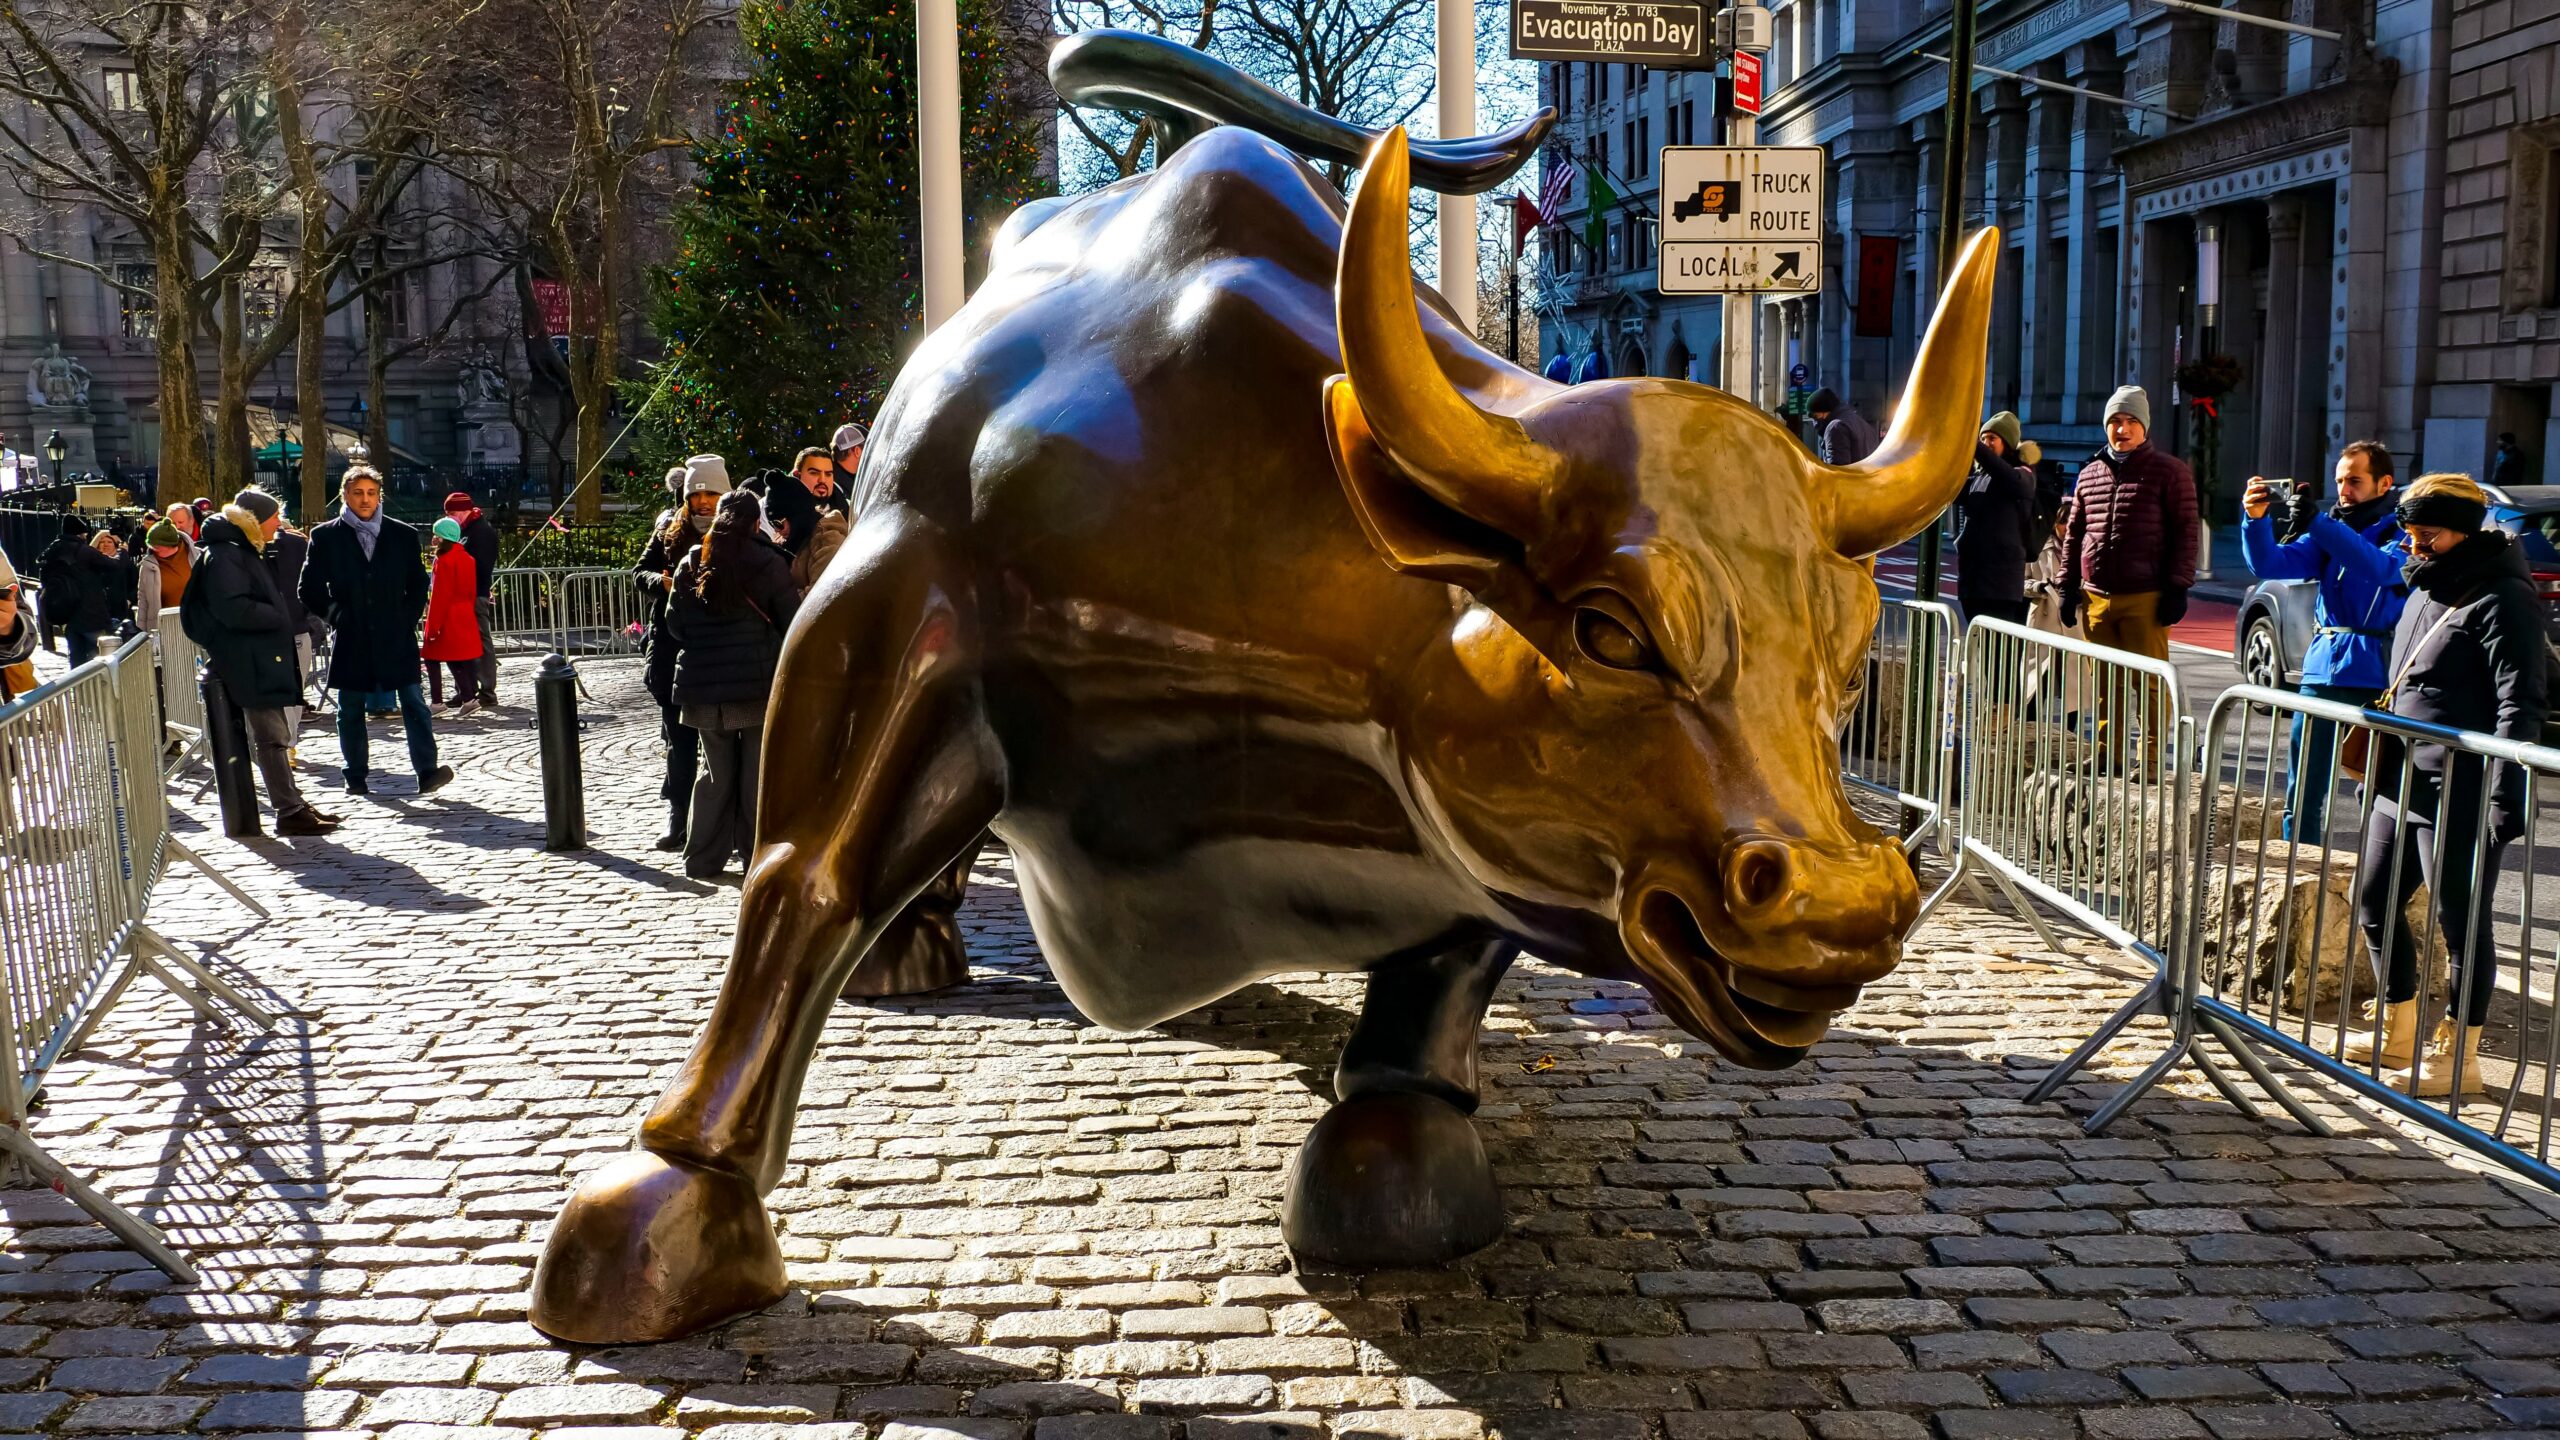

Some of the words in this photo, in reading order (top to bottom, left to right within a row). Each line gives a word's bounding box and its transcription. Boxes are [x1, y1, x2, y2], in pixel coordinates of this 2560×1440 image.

[1561, 3, 1608, 15] November
[1637, 6, 1658, 17] 1783
[1522, 11, 1647, 42] Evacuation
[1652, 17, 1695, 50] Day
[1594, 40, 1625, 52] PLAZA
[1751, 173, 1811, 193] TRUCK
[1750, 211, 1811, 231] ROUTE
[1680, 257, 1743, 277] LOCAL
